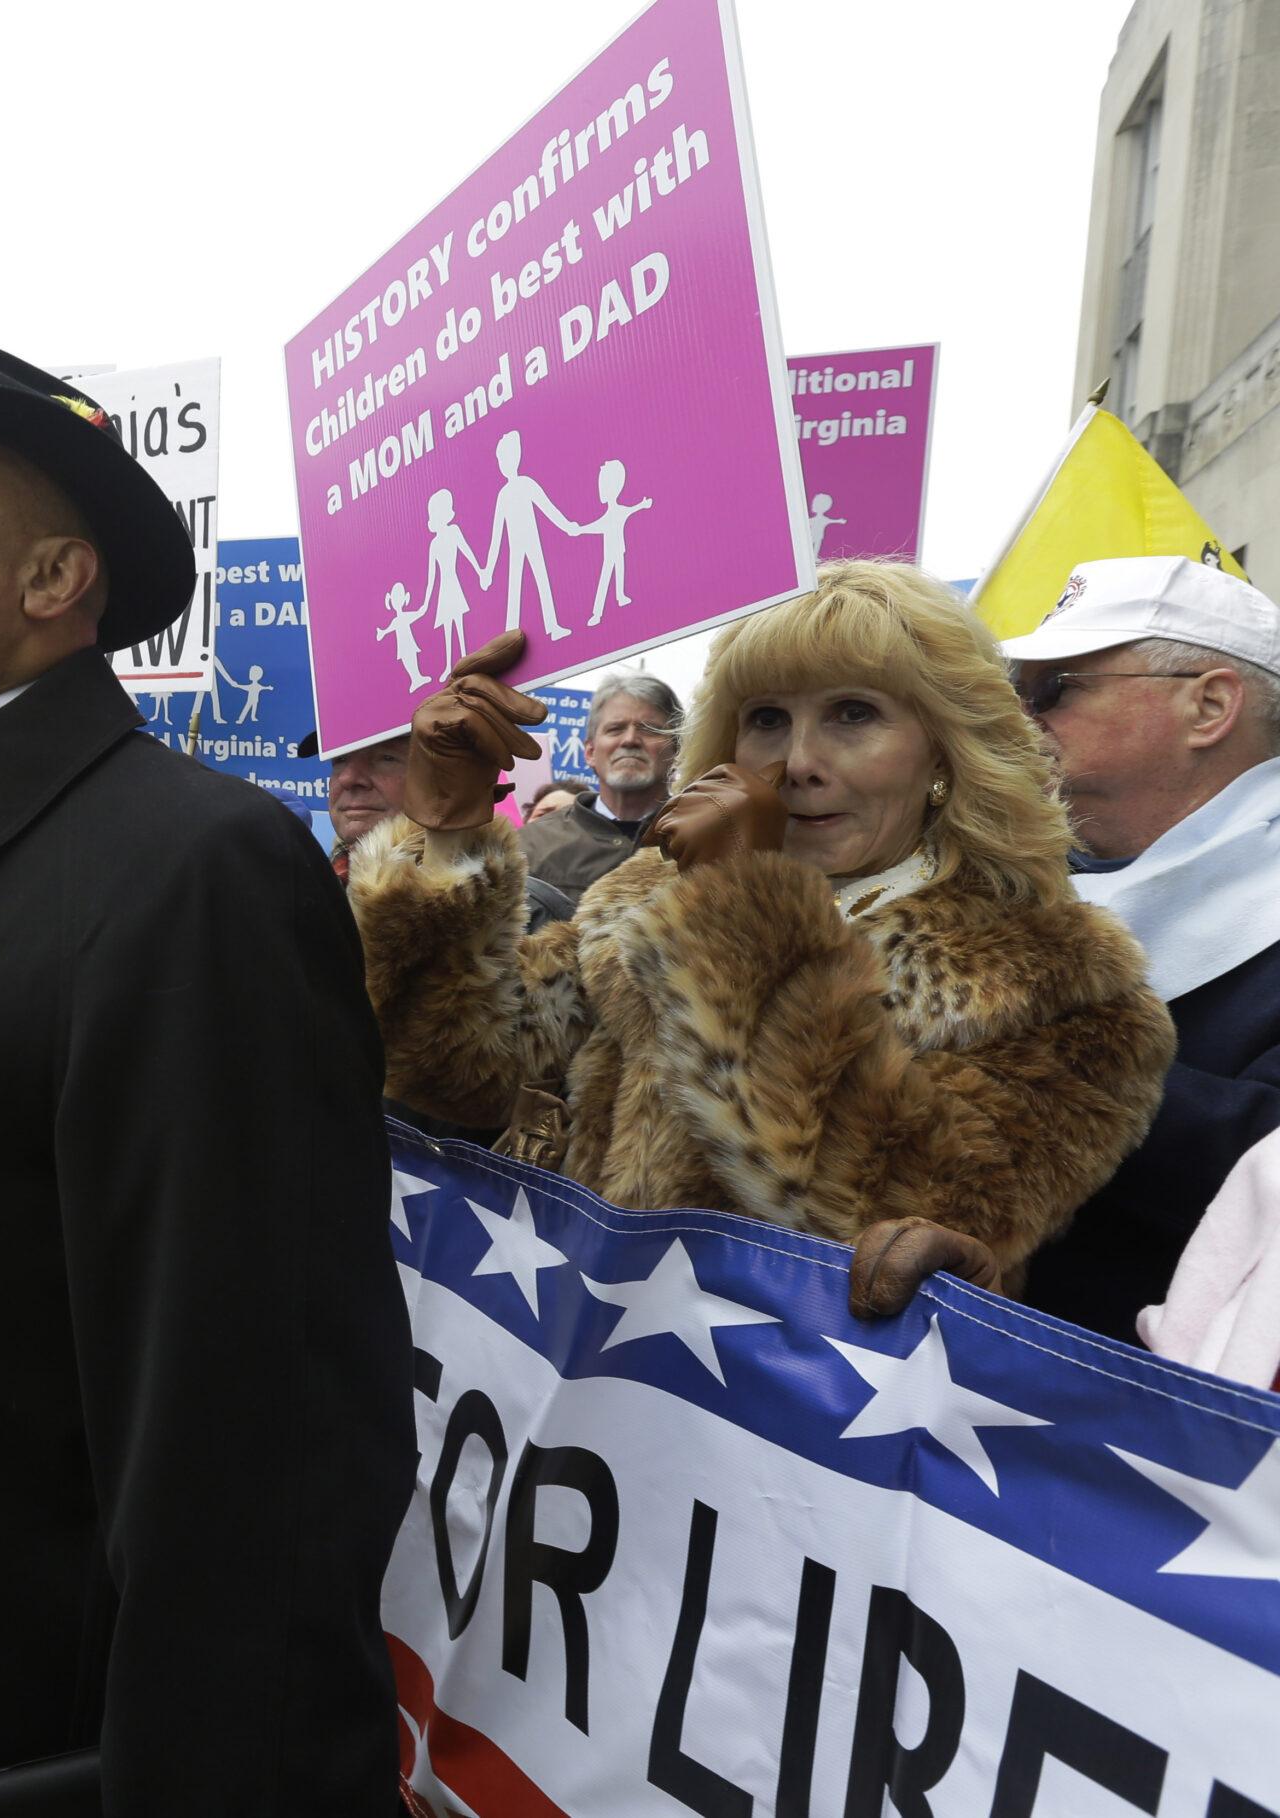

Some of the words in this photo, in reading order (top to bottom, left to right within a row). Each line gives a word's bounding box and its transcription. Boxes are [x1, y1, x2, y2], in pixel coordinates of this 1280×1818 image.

[305, 347, 427, 456] Children
[436, 307, 482, 361] do
[490, 219, 583, 321] best
[592, 123, 710, 241] with
[311, 231, 454, 389] HISTORY
[466, 57, 674, 258] confirms
[327, 484, 342, 515] a
[349, 409, 435, 501] MOM
[444, 353, 513, 438] and
[524, 346, 549, 386] a
[559, 252, 670, 363] DAD
[229, 609, 245, 627] a
[559, 716, 586, 727] and
[560, 696, 578, 708] do
[647, 1498, 1280, 1818] LIB
